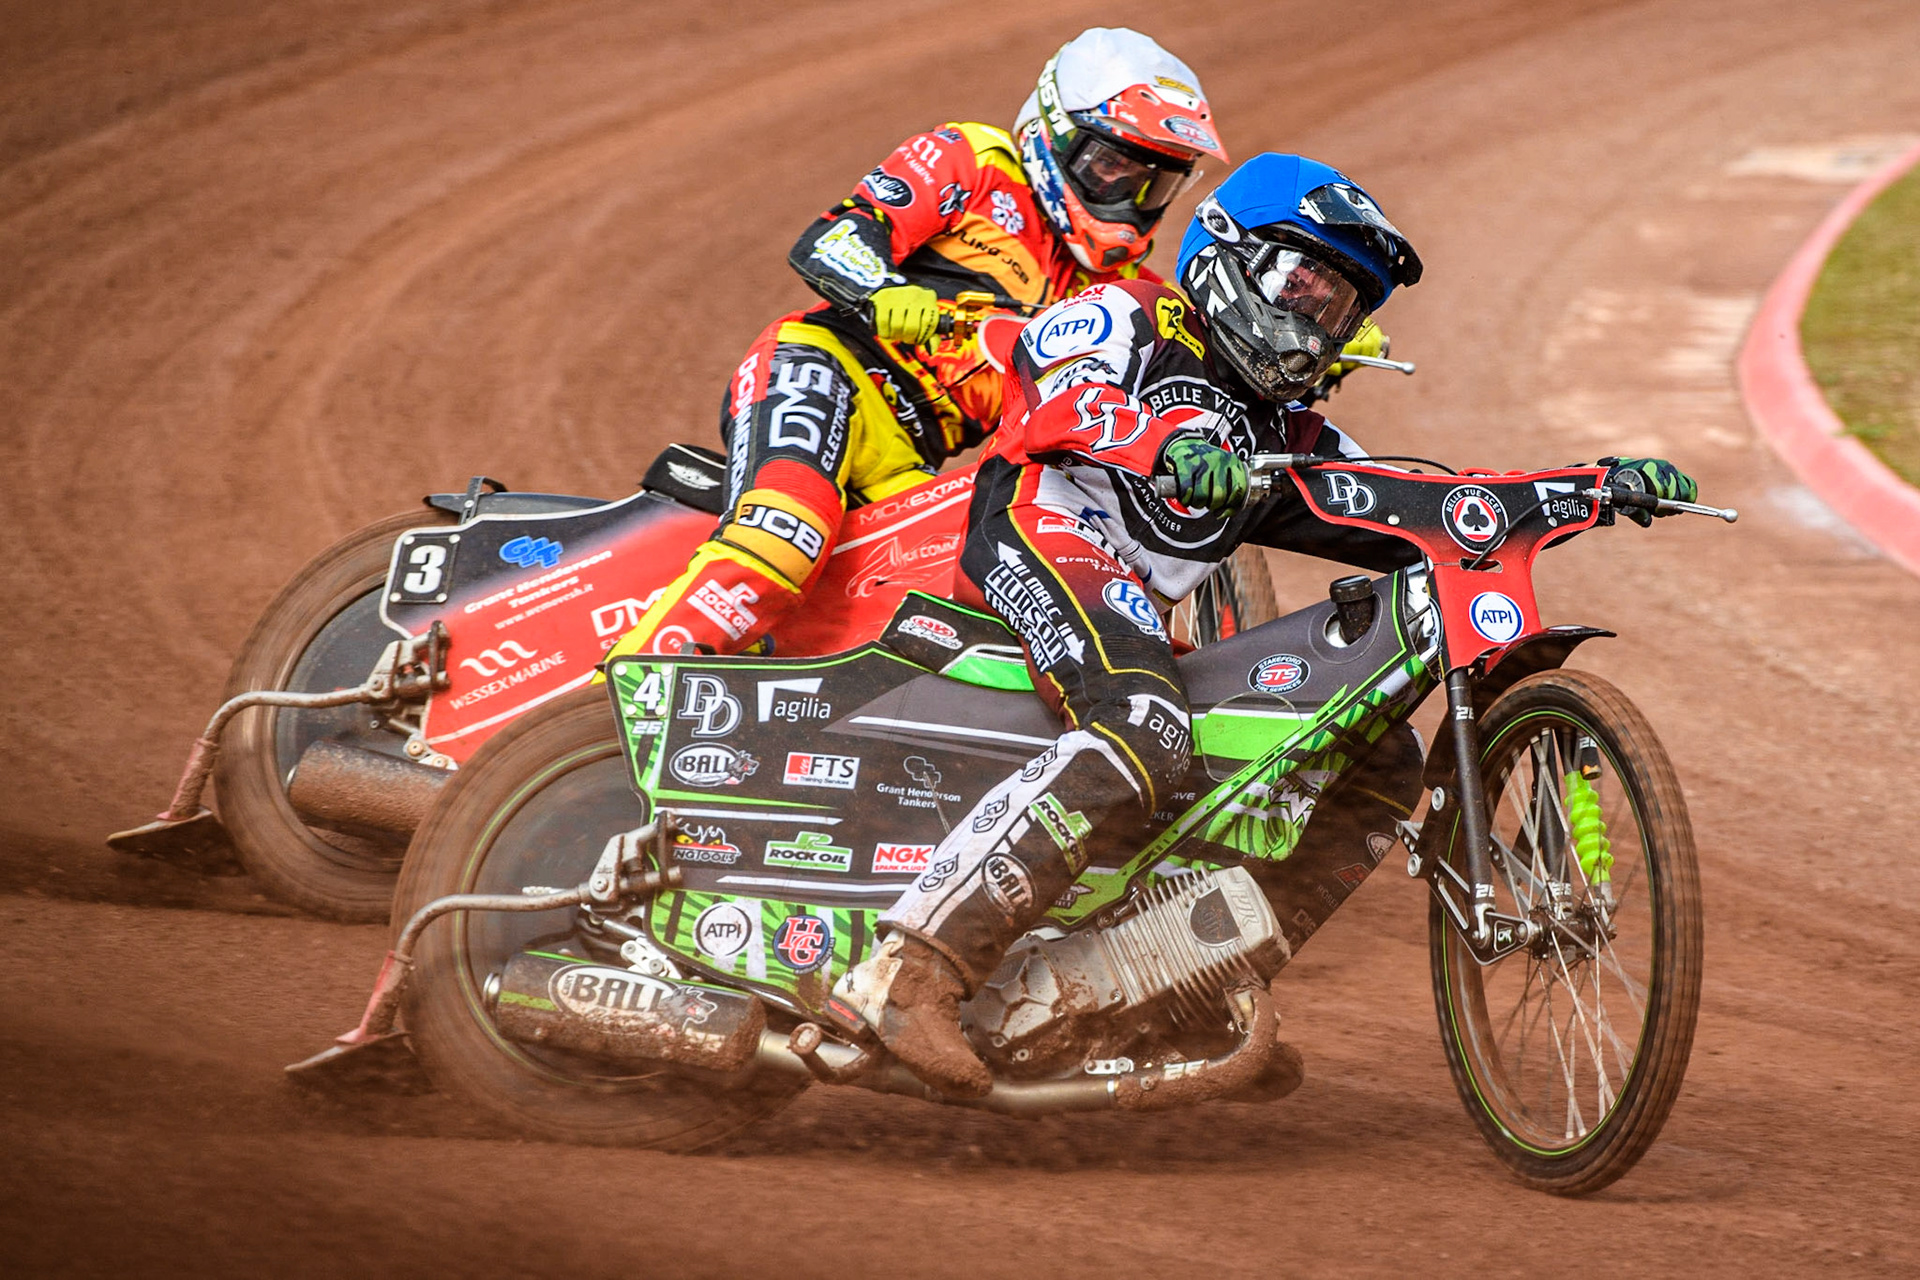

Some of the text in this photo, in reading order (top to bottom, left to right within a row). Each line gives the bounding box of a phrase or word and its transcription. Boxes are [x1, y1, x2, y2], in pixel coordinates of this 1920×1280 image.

[1001, 257, 1030, 284] JCB
[1045, 318, 1096, 342] ATPI
[768, 362, 834, 455] DMS
[1149, 387, 1203, 412] BELLE
[1446, 488, 1502, 514] BELLE VUE ACES
[1551, 497, 1589, 520] agilia
[738, 505, 825, 560] JCB
[403, 545, 447, 594] 3
[464, 550, 613, 614] Grant Henderson
[508, 575, 580, 609] Tankers
[1025, 572, 1063, 623] MALC
[695, 586, 751, 635] ROCK OIL
[1480, 608, 1513, 624] ATPI
[984, 585, 1051, 673] TRANSPORT
[1257, 656, 1302, 669] STAKEFORD
[1259, 667, 1298, 682] STS
[633, 673, 662, 711] 4
[1269, 679, 1302, 693] SERVICES
[774, 697, 832, 722] agilia
[631, 720, 664, 735] 26
[809, 756, 855, 778] FTS
[800, 776, 822, 784] Training
[824, 777, 849, 786] Services
[876, 783, 905, 796] Grant
[898, 796, 937, 809] Tankers
[1036, 800, 1075, 844] ROCK
[768, 848, 847, 865] ROCK OIL
[876, 845, 932, 864] NGK
[704, 923, 741, 939] ATPI
